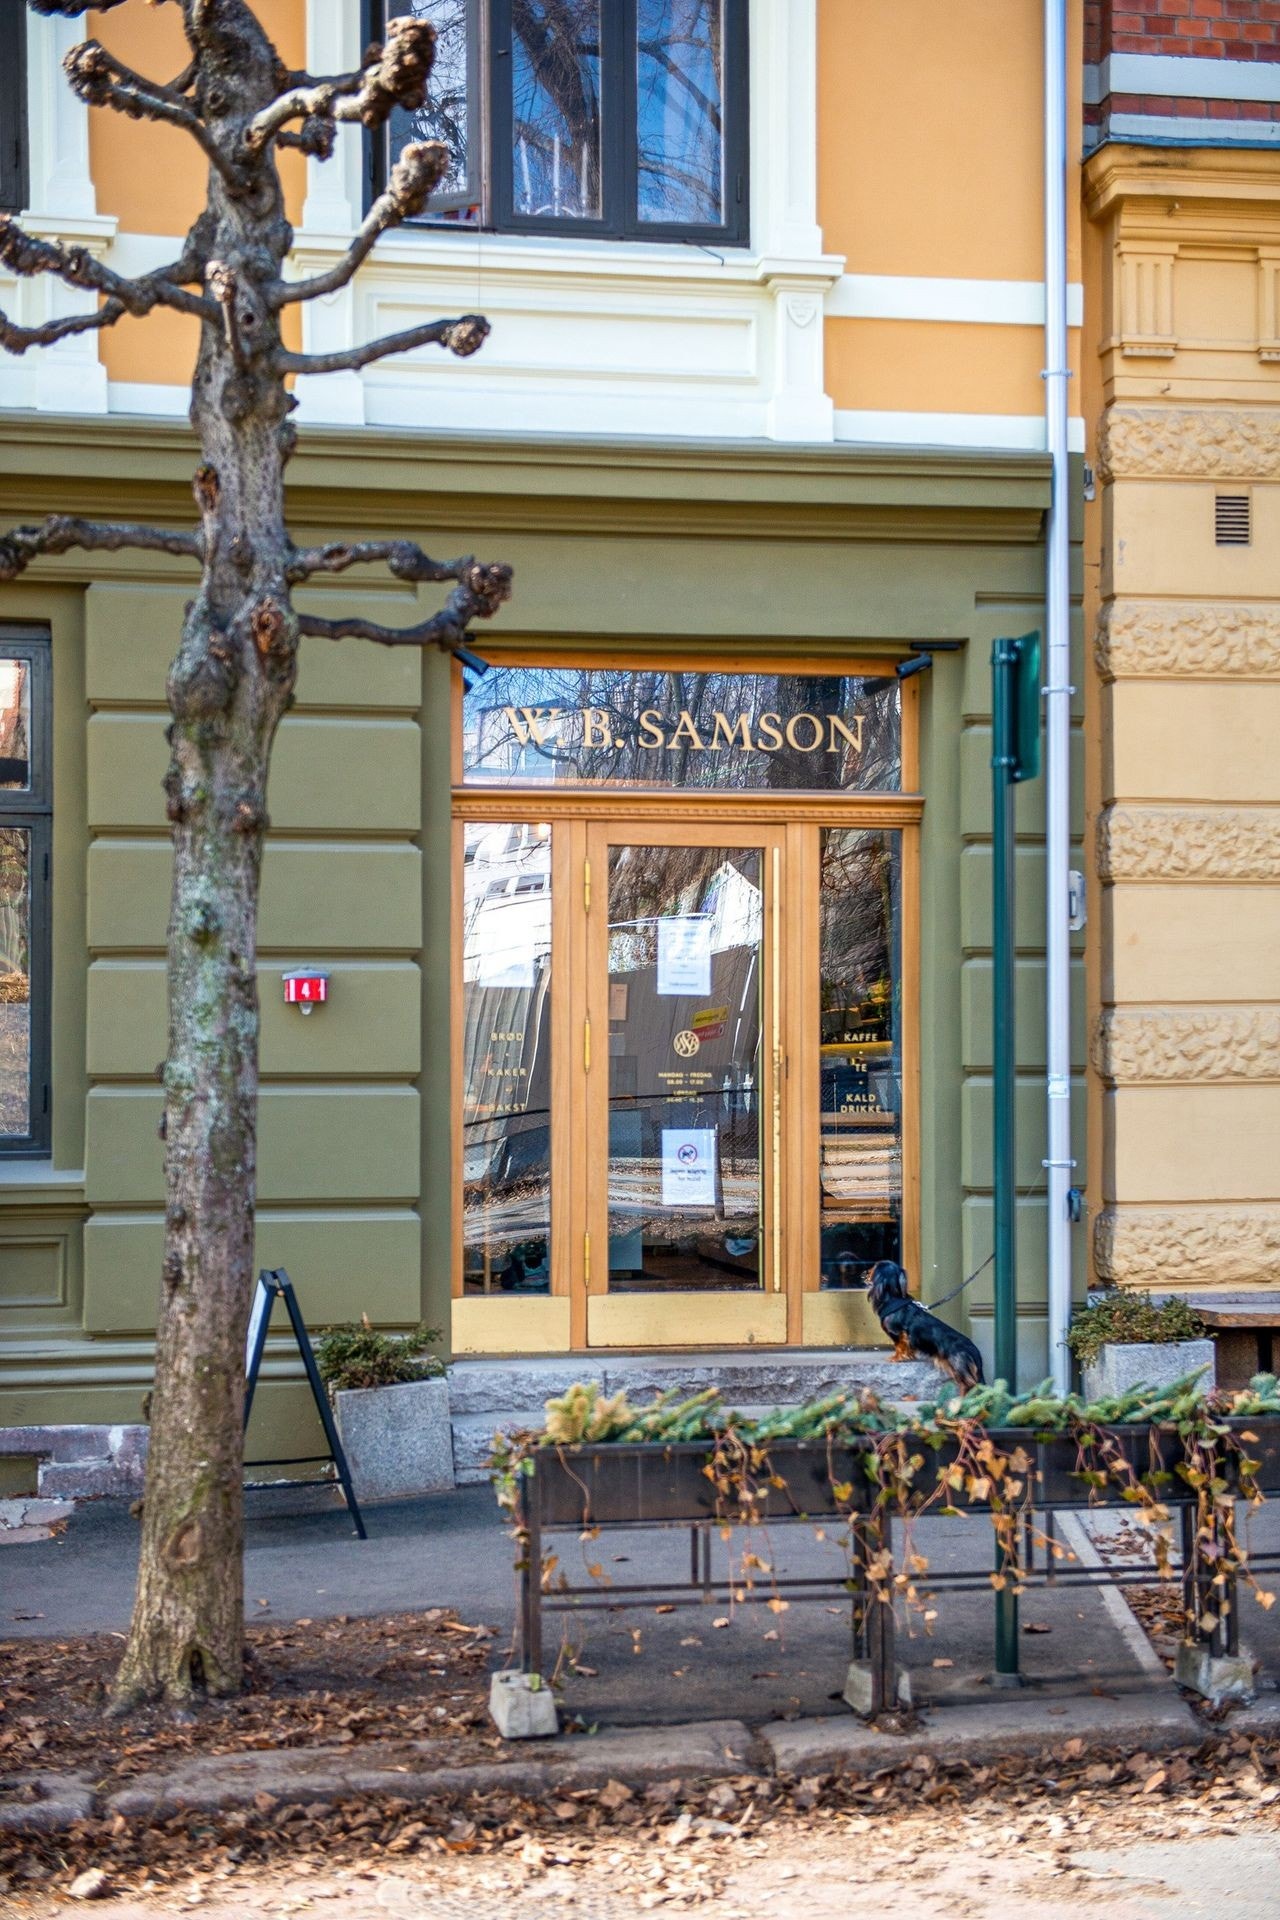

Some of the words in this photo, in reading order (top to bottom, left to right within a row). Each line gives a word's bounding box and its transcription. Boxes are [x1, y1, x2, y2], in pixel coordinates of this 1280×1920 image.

[505, 708, 565, 748] W.
[582, 709, 624, 749] B.
[638, 711, 866, 753] SAMSON
[491, 1032, 523, 1041] BRØD
[844, 1033, 878, 1042] KAFFE
[488, 1068, 527, 1077] KAKER
[855, 1063, 868, 1073] TE
[846, 1094, 877, 1102] KALD
[488, 1103, 526, 1112] BAKST
[840, 1105, 882, 1113] DRIKKE
